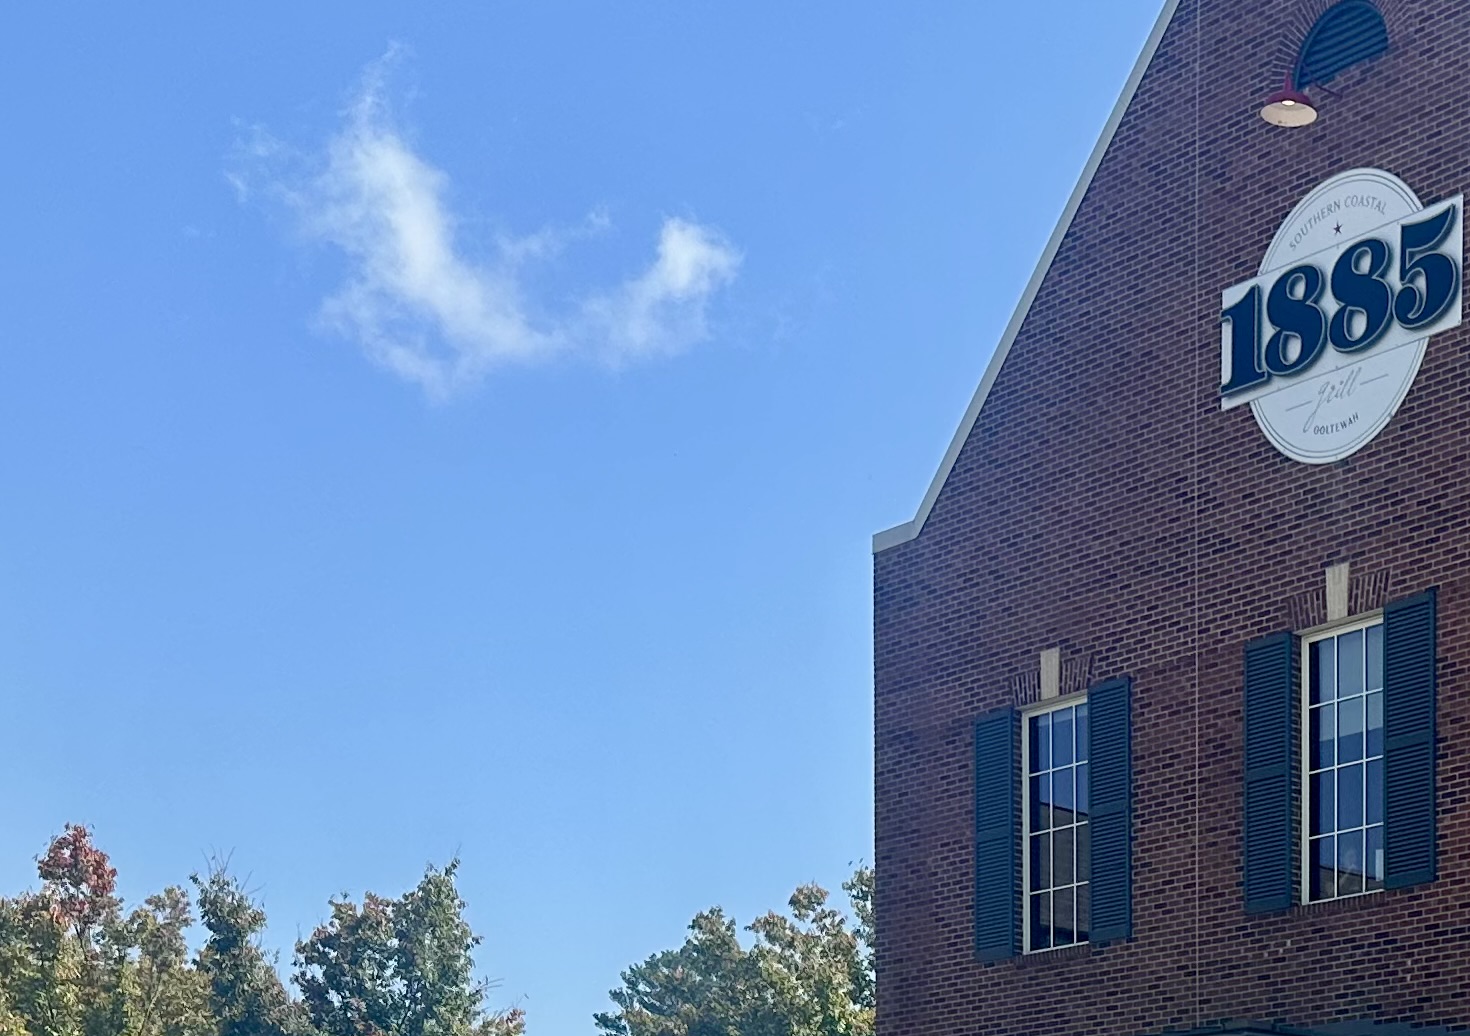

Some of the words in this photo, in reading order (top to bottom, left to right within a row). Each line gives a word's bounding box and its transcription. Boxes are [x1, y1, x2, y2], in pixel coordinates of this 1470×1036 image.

[1289, 199, 1341, 251] SOUTHERN
[1344, 195, 1386, 215] COASTAL
[1220, 204, 1457, 397] 1885
[1313, 412, 1359, 435] OOLTEWAH
